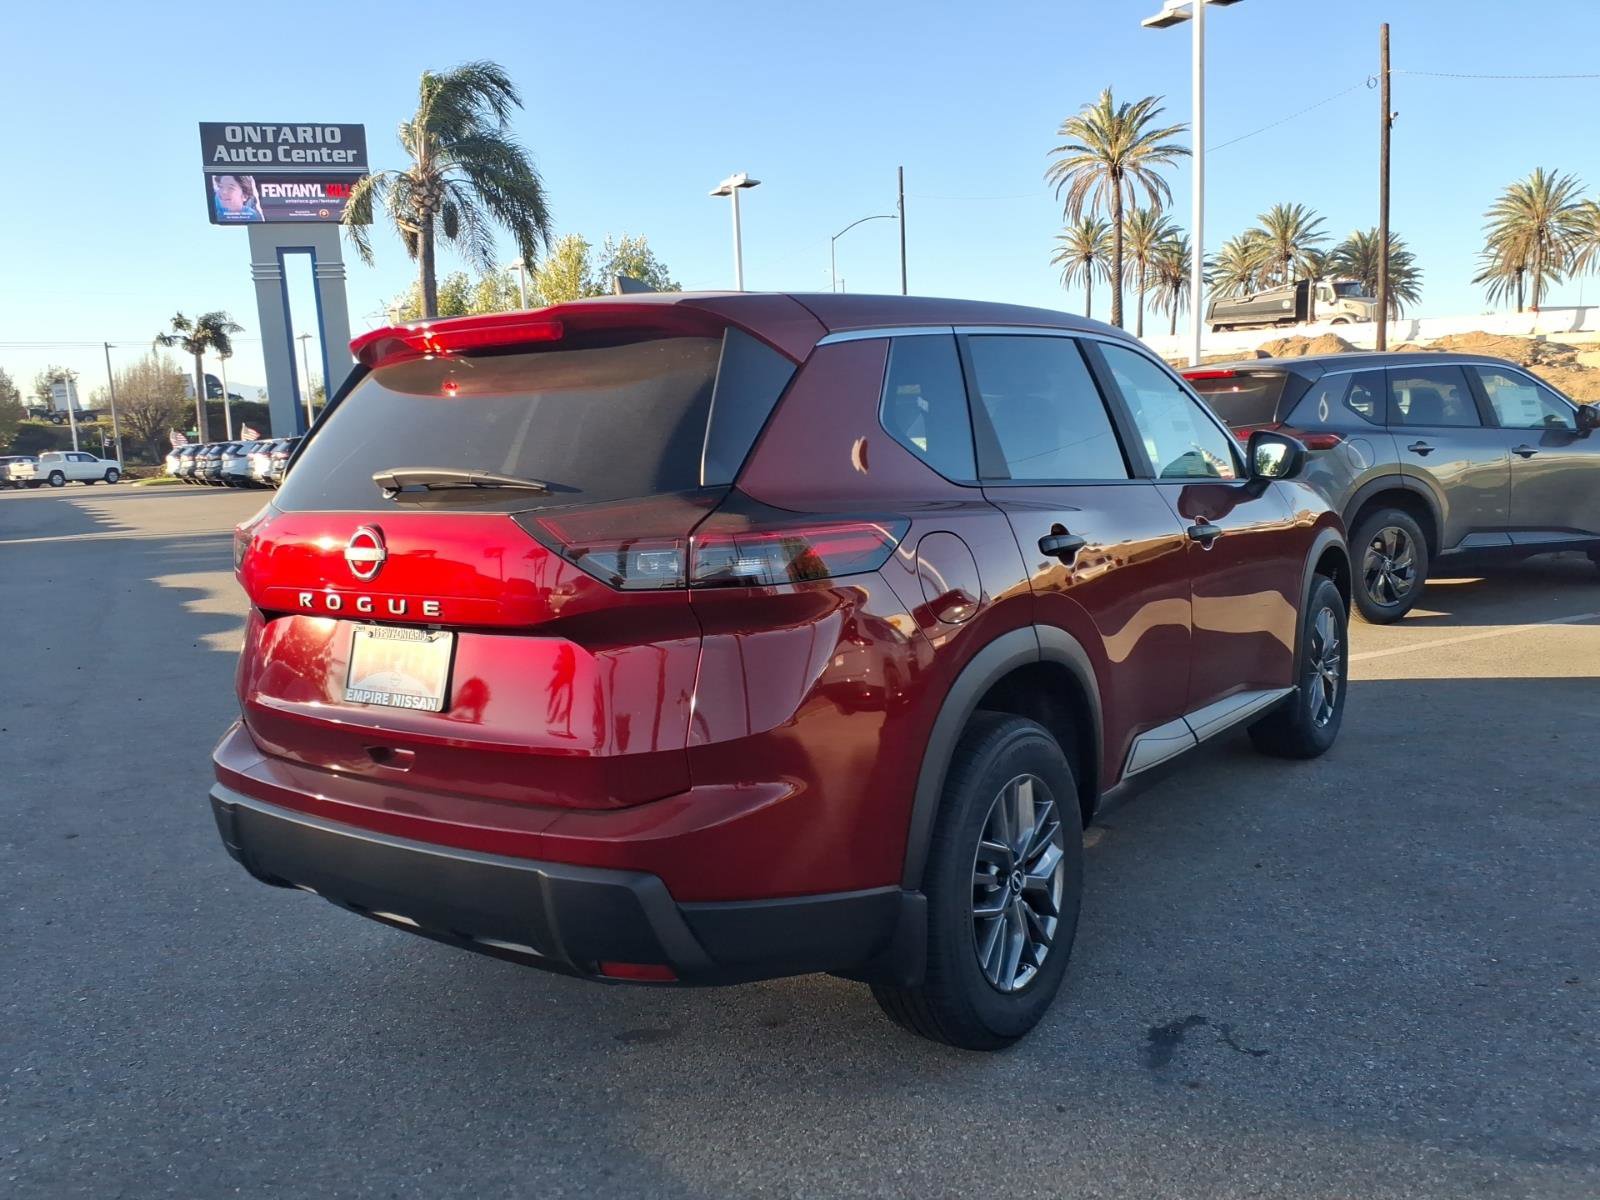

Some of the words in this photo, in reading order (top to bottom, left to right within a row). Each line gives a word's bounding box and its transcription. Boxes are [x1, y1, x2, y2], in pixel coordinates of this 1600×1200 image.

[225, 126, 341, 143] ONTARIO
[213, 145, 272, 162] Auto
[277, 145, 357, 163] Center
[261, 183, 325, 198] FENTANYL
[299, 592, 440, 616] ROGUE
[346, 688, 389, 705] EMPIRE
[392, 694, 437, 711] NISSAN
